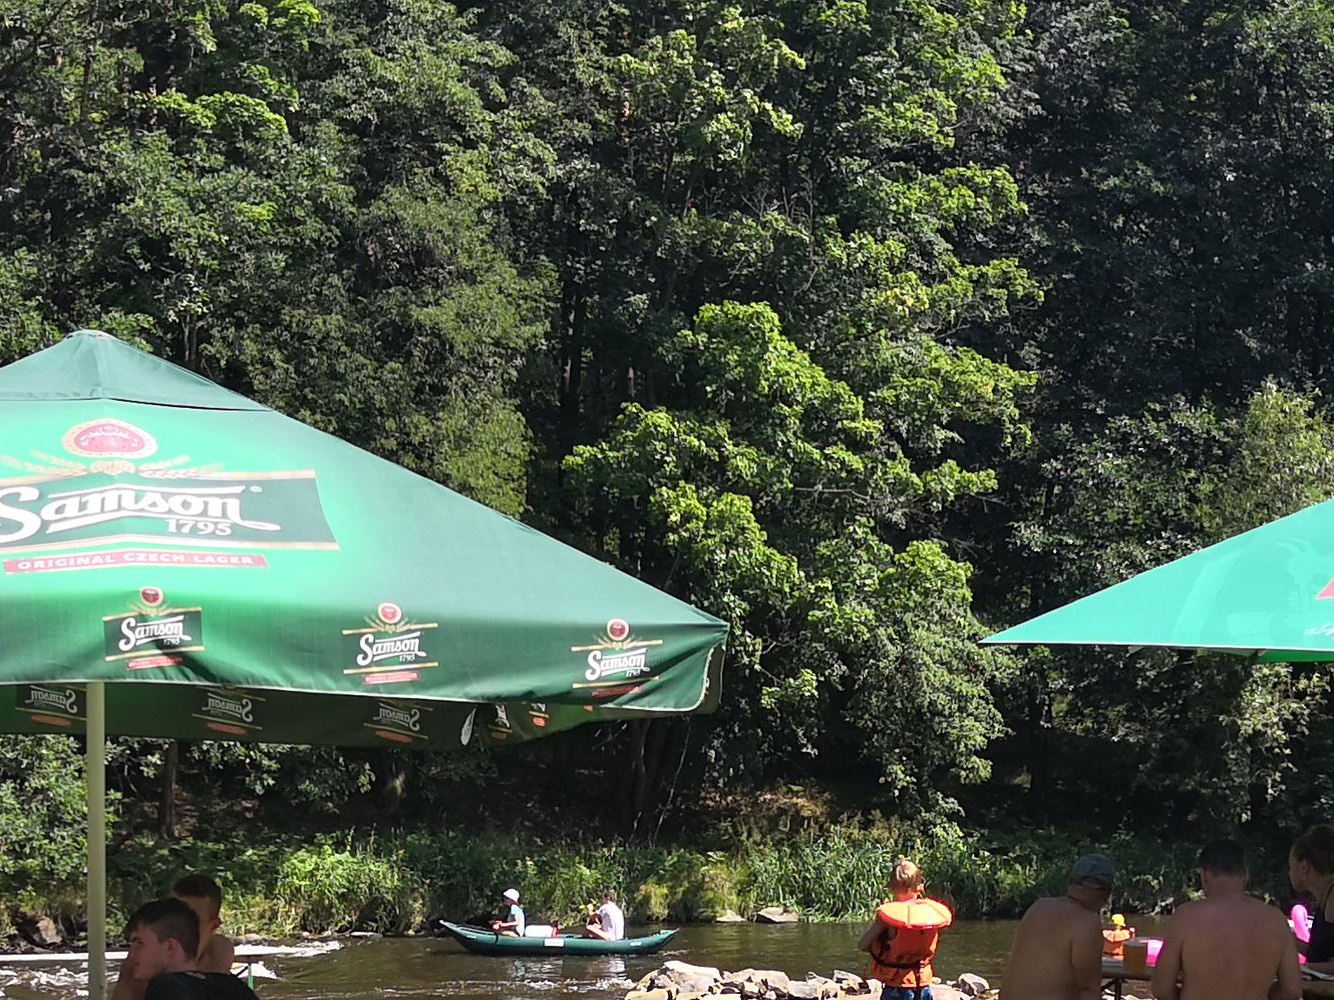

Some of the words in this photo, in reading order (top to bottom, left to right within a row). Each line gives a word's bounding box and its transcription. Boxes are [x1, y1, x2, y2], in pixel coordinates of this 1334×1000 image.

[165, 519, 231, 536] 1795
[17, 555, 115, 570] ORIGINAL
[123, 552, 185, 563] CZECH
[193, 555, 254, 565] LAGER
[118, 615, 192, 652] Samson
[356, 631, 427, 666] Samson
[585, 648, 651, 681] Samson
